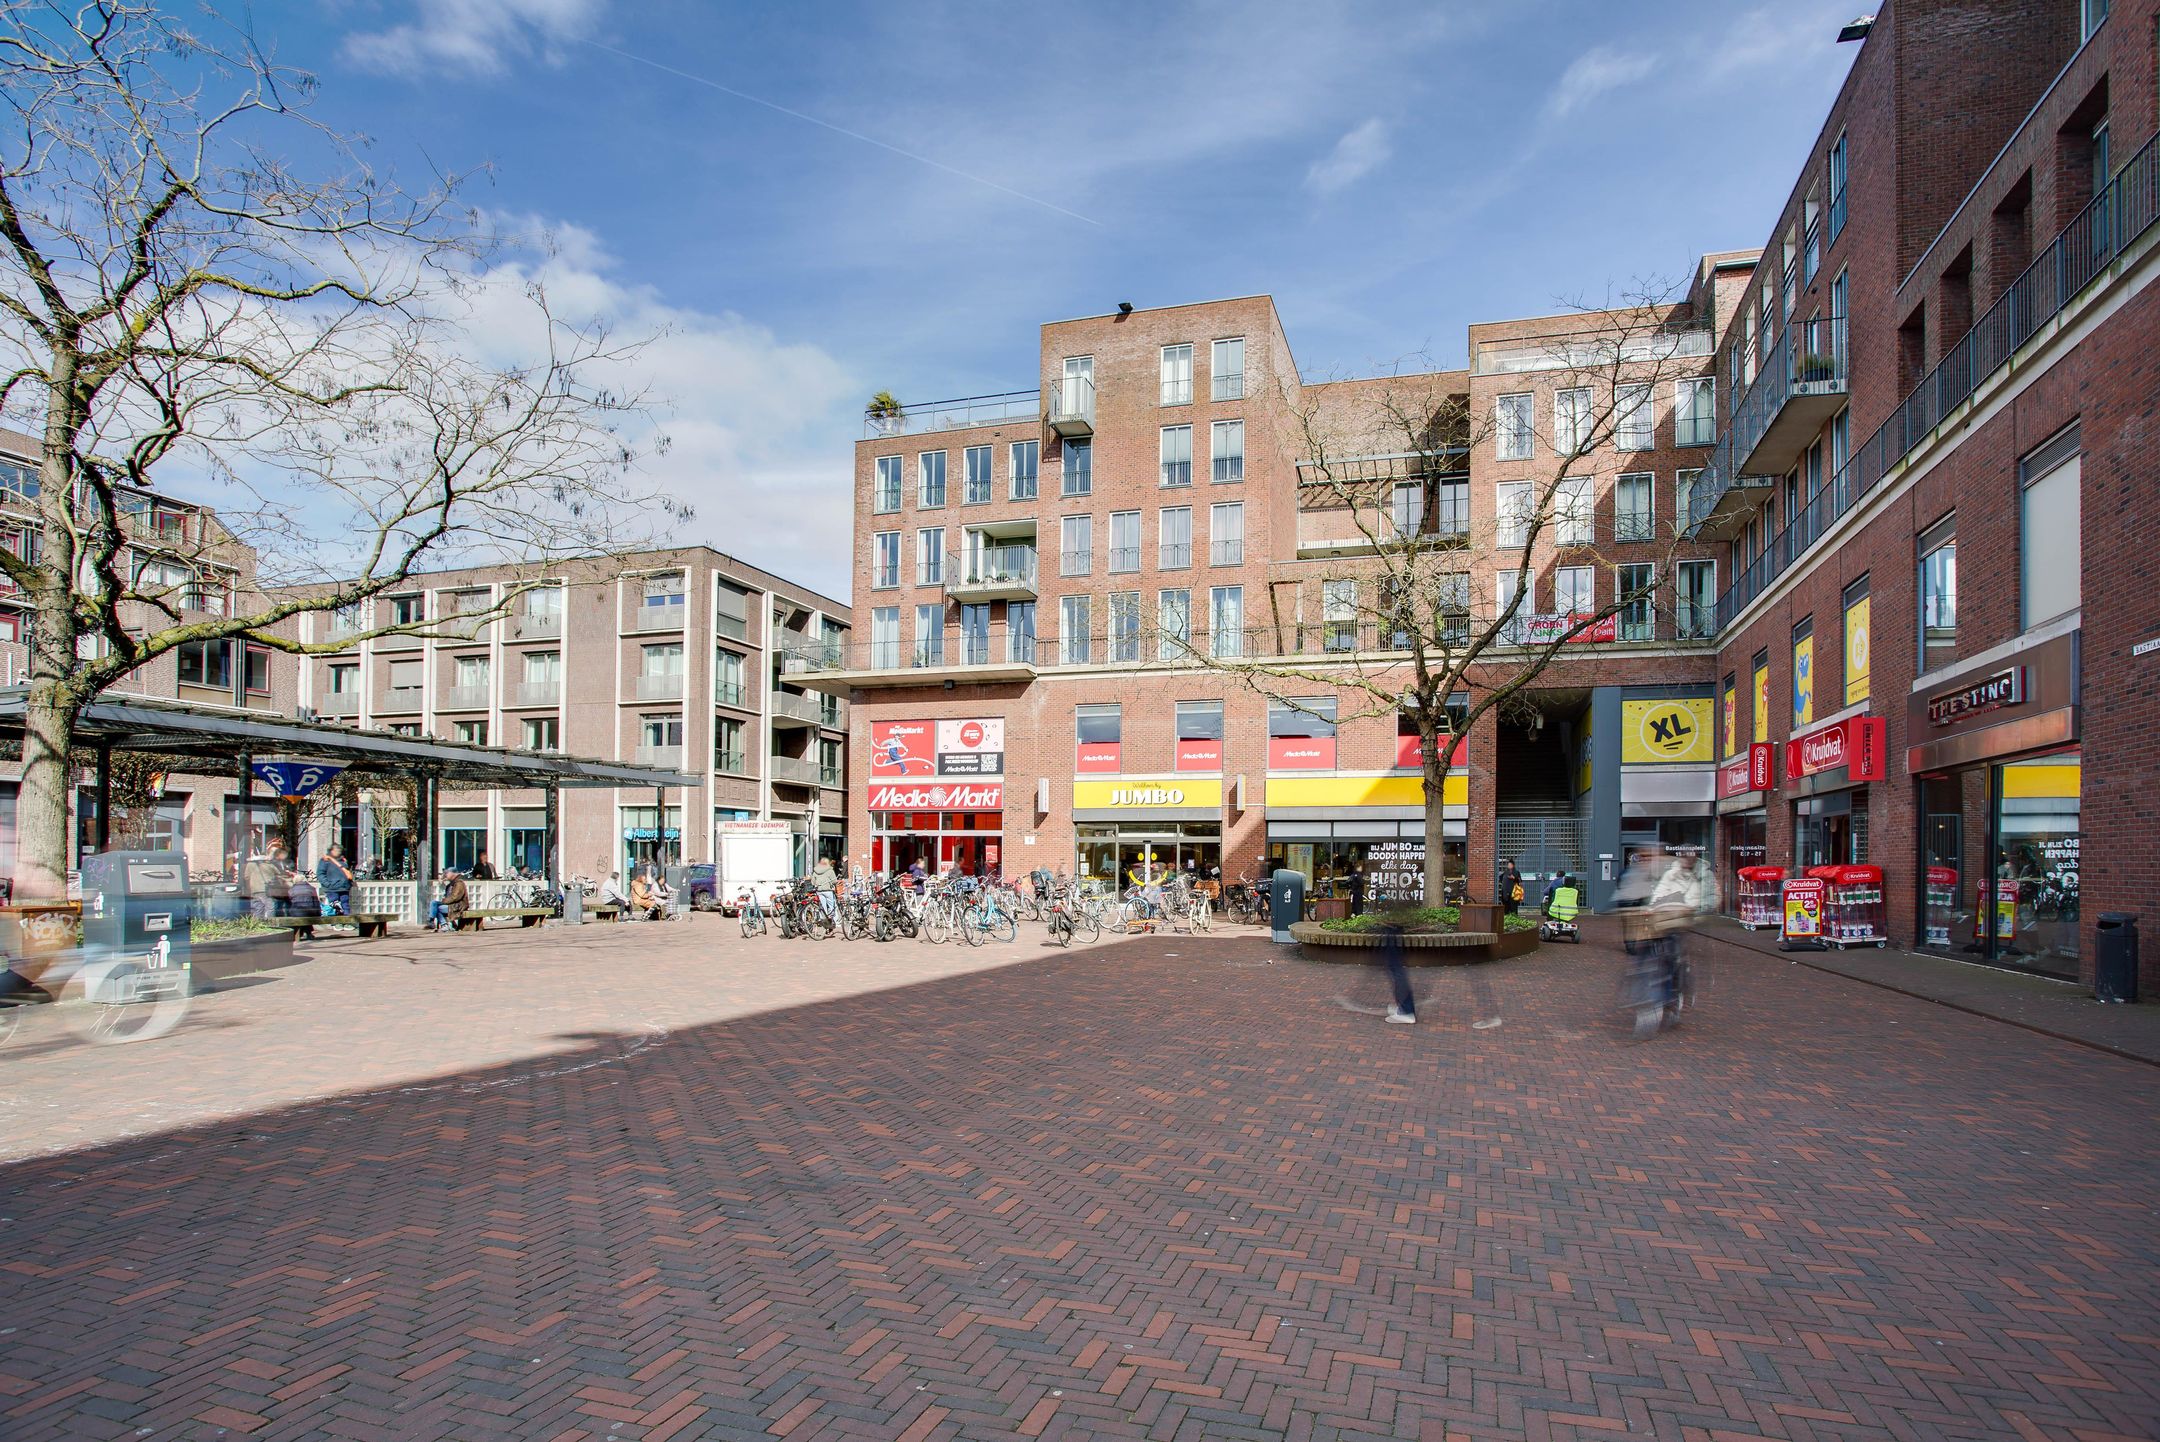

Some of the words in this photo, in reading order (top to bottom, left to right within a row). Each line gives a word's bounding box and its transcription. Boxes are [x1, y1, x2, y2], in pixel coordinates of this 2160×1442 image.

[1928, 696, 1957, 719] THE
[1650, 713, 1692, 743] XL
[1812, 734, 1842, 763] Kruidvat
[295, 774, 318, 791] P
[870, 787, 931, 807] Media
[942, 786, 1000, 807] Markt
[1111, 790, 1184, 805] JUMBO
[634, 829, 658, 838] Albert
[664, 829, 679, 840] eijn
[1380, 842, 1412, 851] JUMBO
[1793, 880, 1819, 888] Kruidvat
[1787, 891, 1818, 900] ACTIE!
